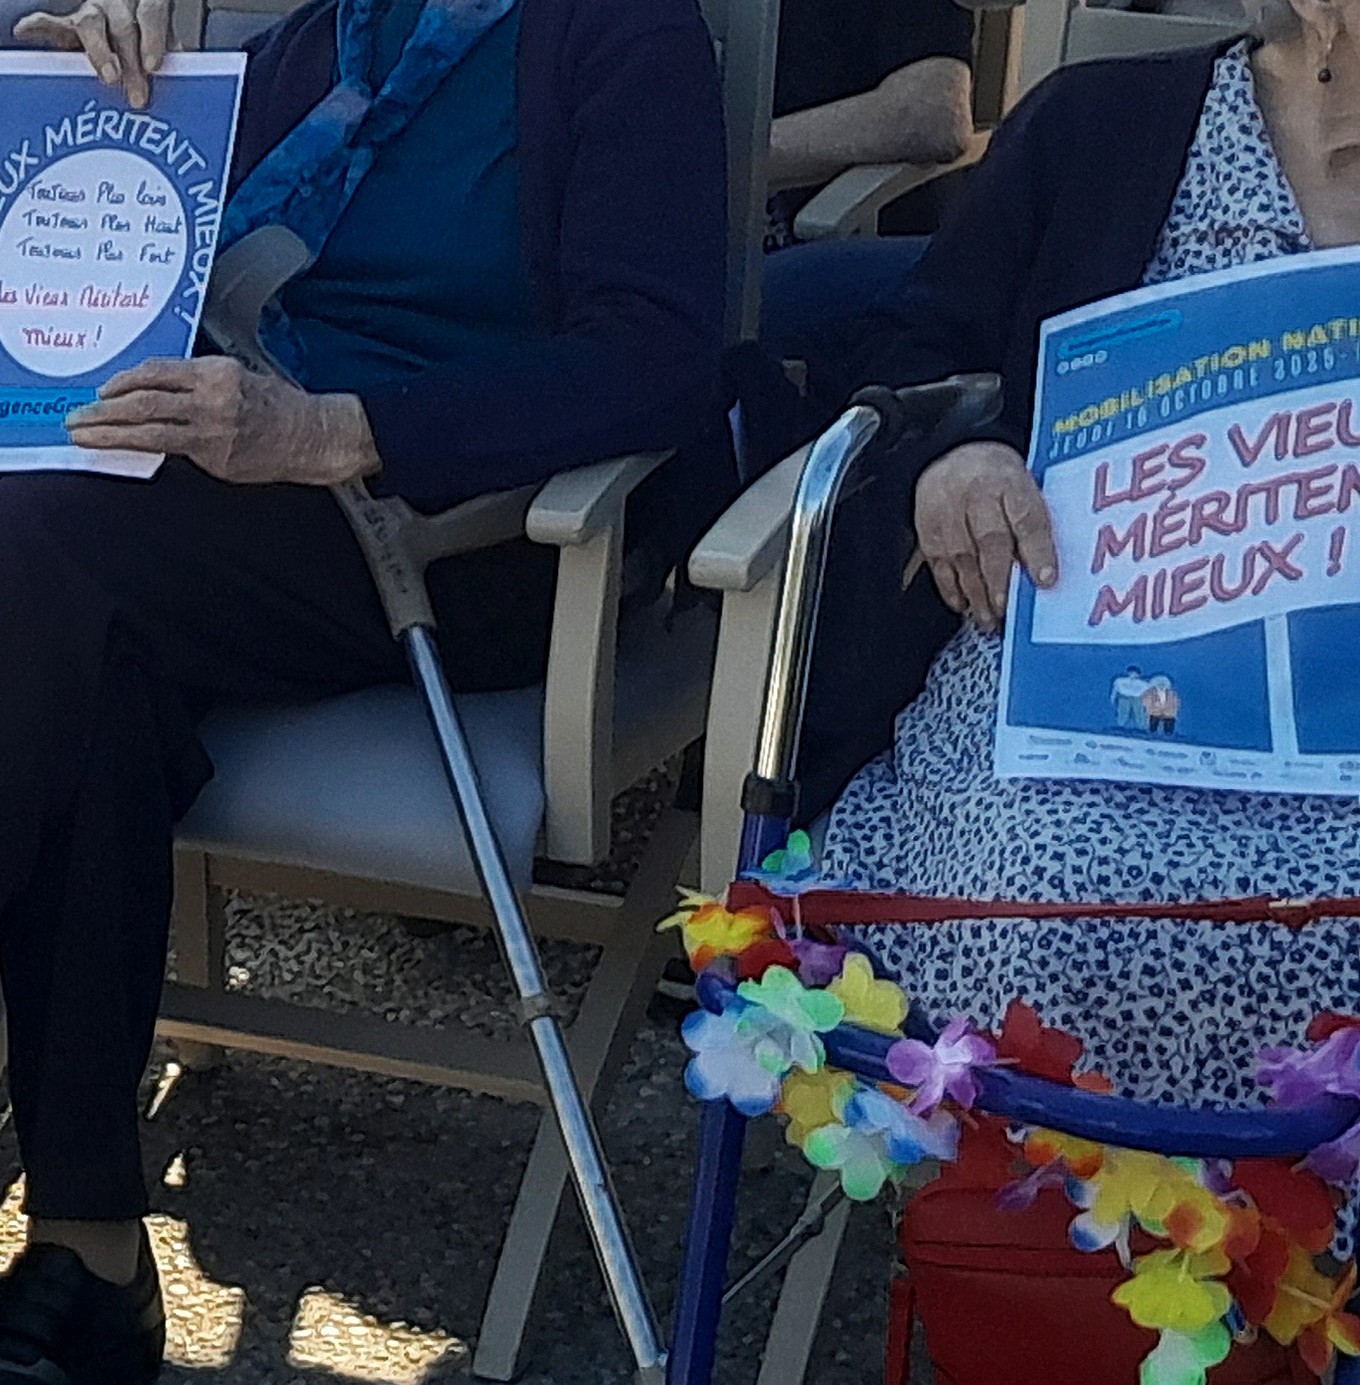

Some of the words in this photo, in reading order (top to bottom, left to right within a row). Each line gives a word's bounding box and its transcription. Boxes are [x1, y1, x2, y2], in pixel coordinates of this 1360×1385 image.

[44, 99, 207, 177] MÉRITENT
[139, 243, 177, 264] Fort
[1052, 338, 1272, 435] MOBILISATION
[1282, 317, 1360, 352] NATI
[1091, 432, 1208, 511] LES
[1086, 530, 1305, 628] MIEUX
[1326, 525, 1347, 577] !
